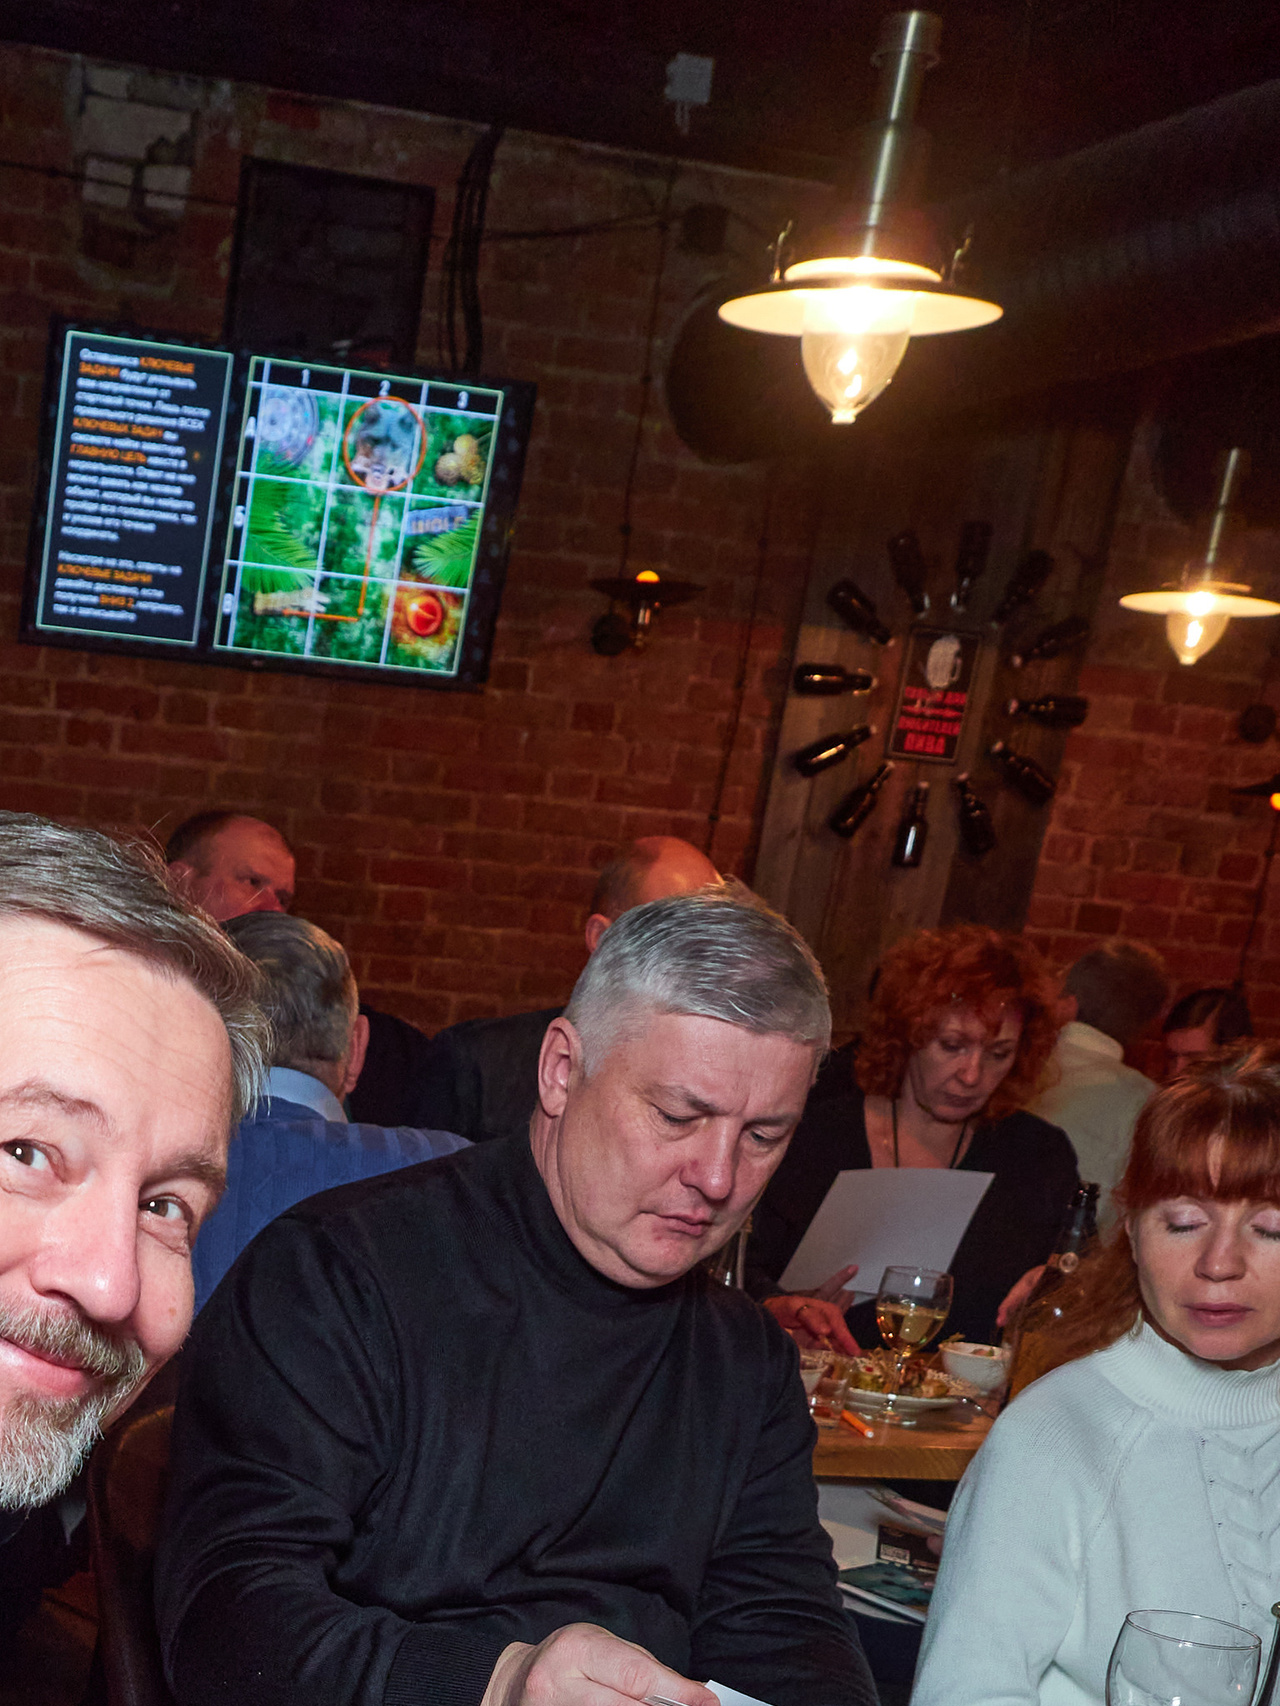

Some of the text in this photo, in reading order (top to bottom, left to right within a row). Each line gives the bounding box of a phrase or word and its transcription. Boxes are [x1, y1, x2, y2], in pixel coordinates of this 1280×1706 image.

[302, 368, 469, 409] 1 2 3
